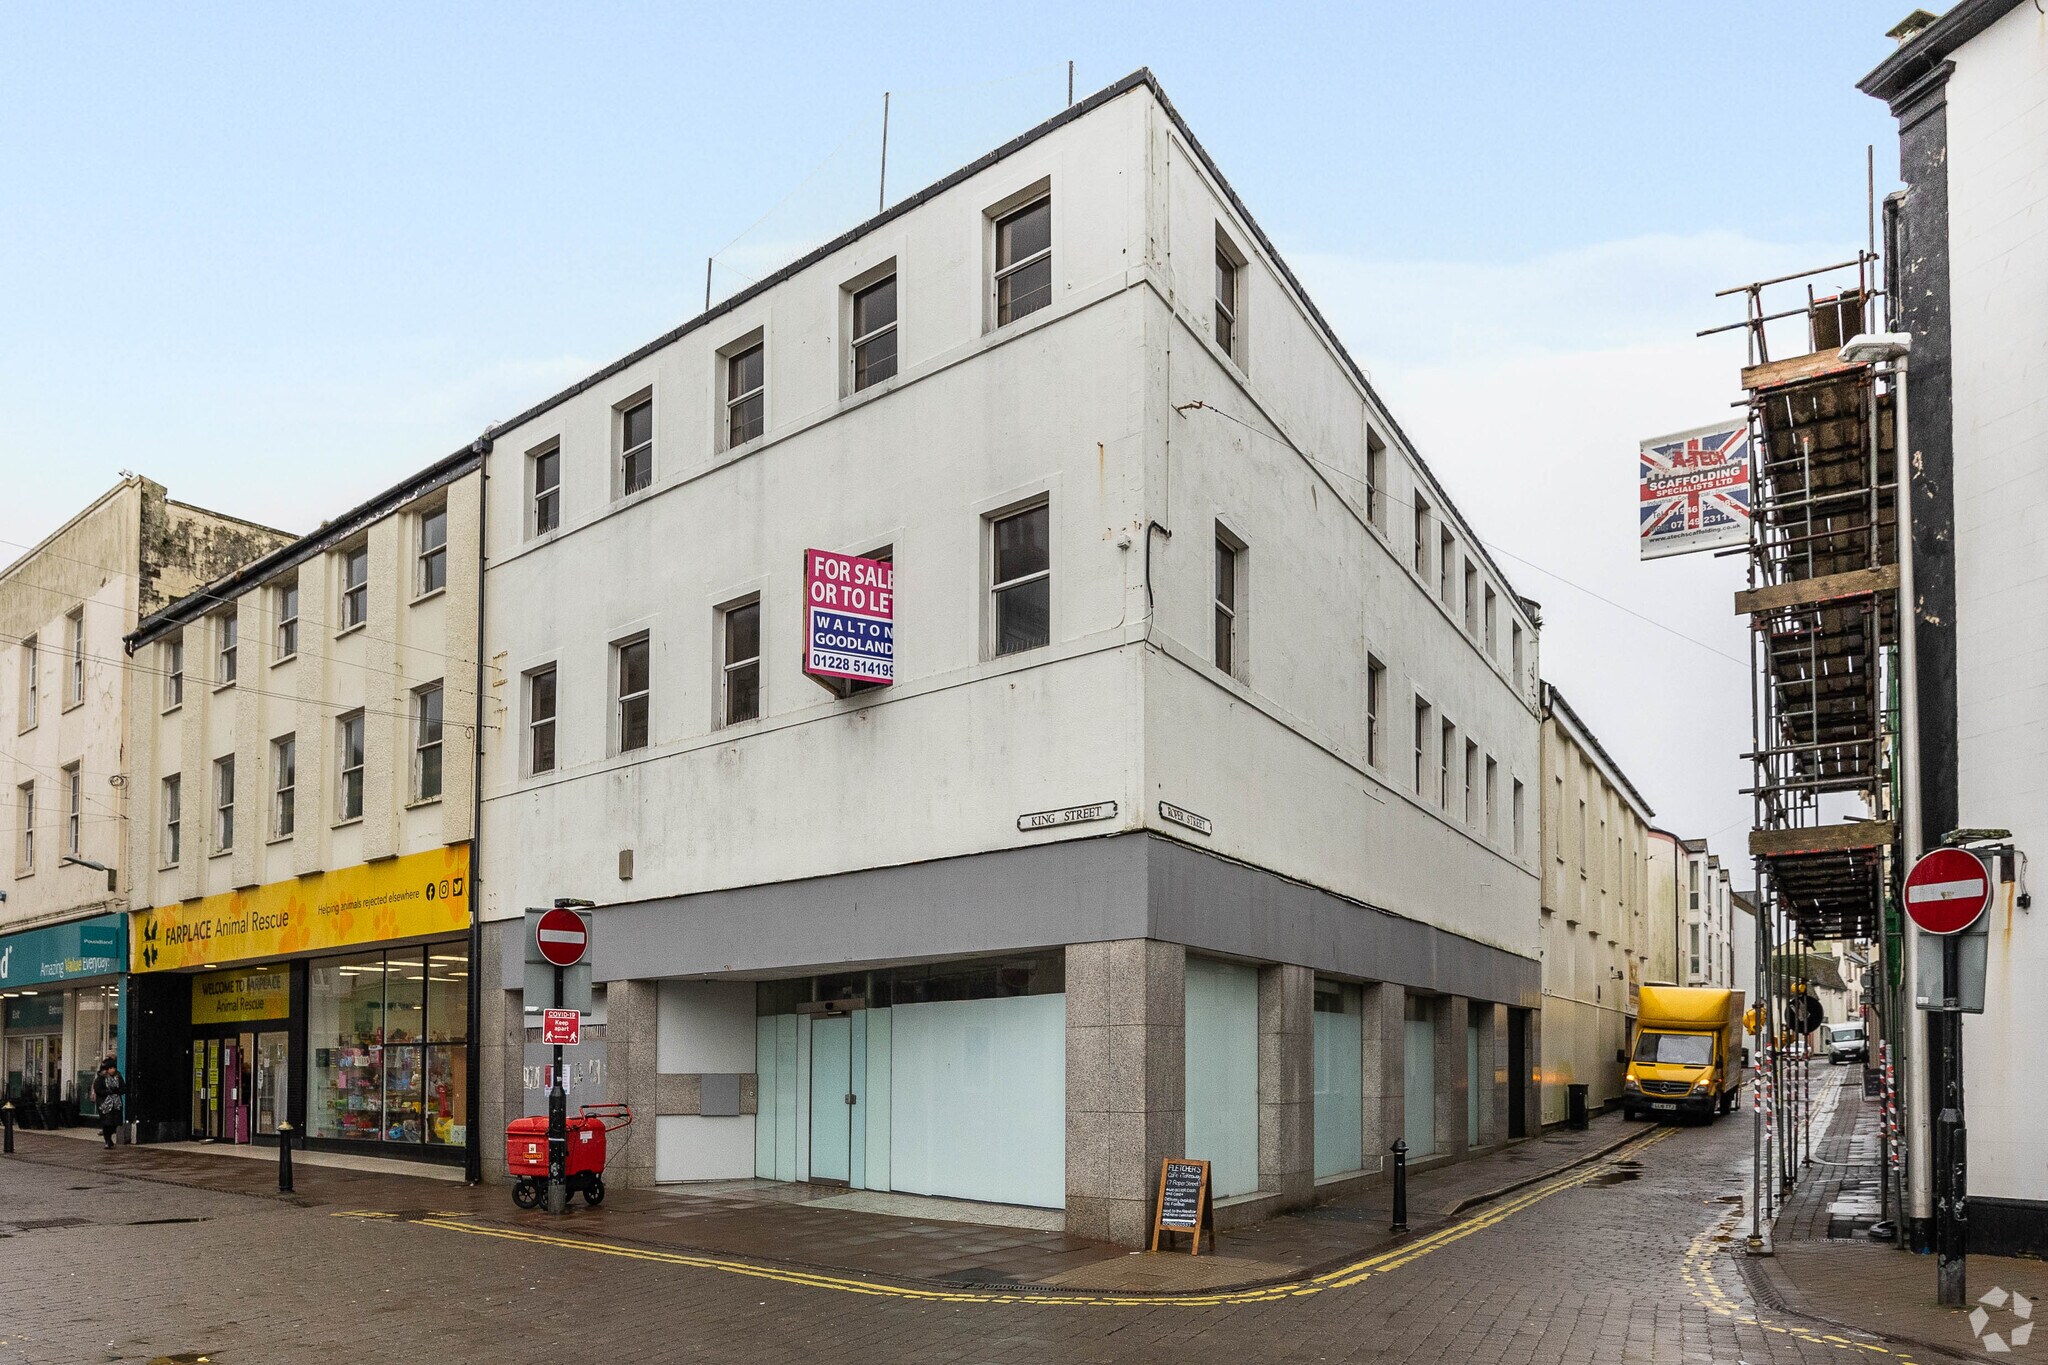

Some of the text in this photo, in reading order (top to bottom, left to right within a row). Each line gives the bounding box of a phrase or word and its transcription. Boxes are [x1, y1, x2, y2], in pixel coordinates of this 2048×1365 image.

[1650, 467, 1740, 490] SCAFFOLDING
[1657, 478, 1733, 497] SPECIALISTS LTD
[815, 556, 893, 590] FOR SALE
[811, 581, 837, 605] OR
[841, 586, 866, 609] TO
[816, 616, 893, 639] WALTON
[815, 632, 893, 655] GOODLAND
[814, 654, 893, 678] 01228 514199
[1031, 806, 1102, 826] KING STREET
[1167, 806, 1206, 830] ROPER STREET
[318, 889, 420, 916] Helping animals rejected elsewhere
[166, 912, 288, 945] FARPLACE Animal Rescue
[40, 960, 64, 978] Amazing
[64, 957, 82, 972] Value
[202, 980, 234, 996] WELCOME
[236, 980, 244, 992] TO
[216, 997, 264, 1012] Animal Rescue
